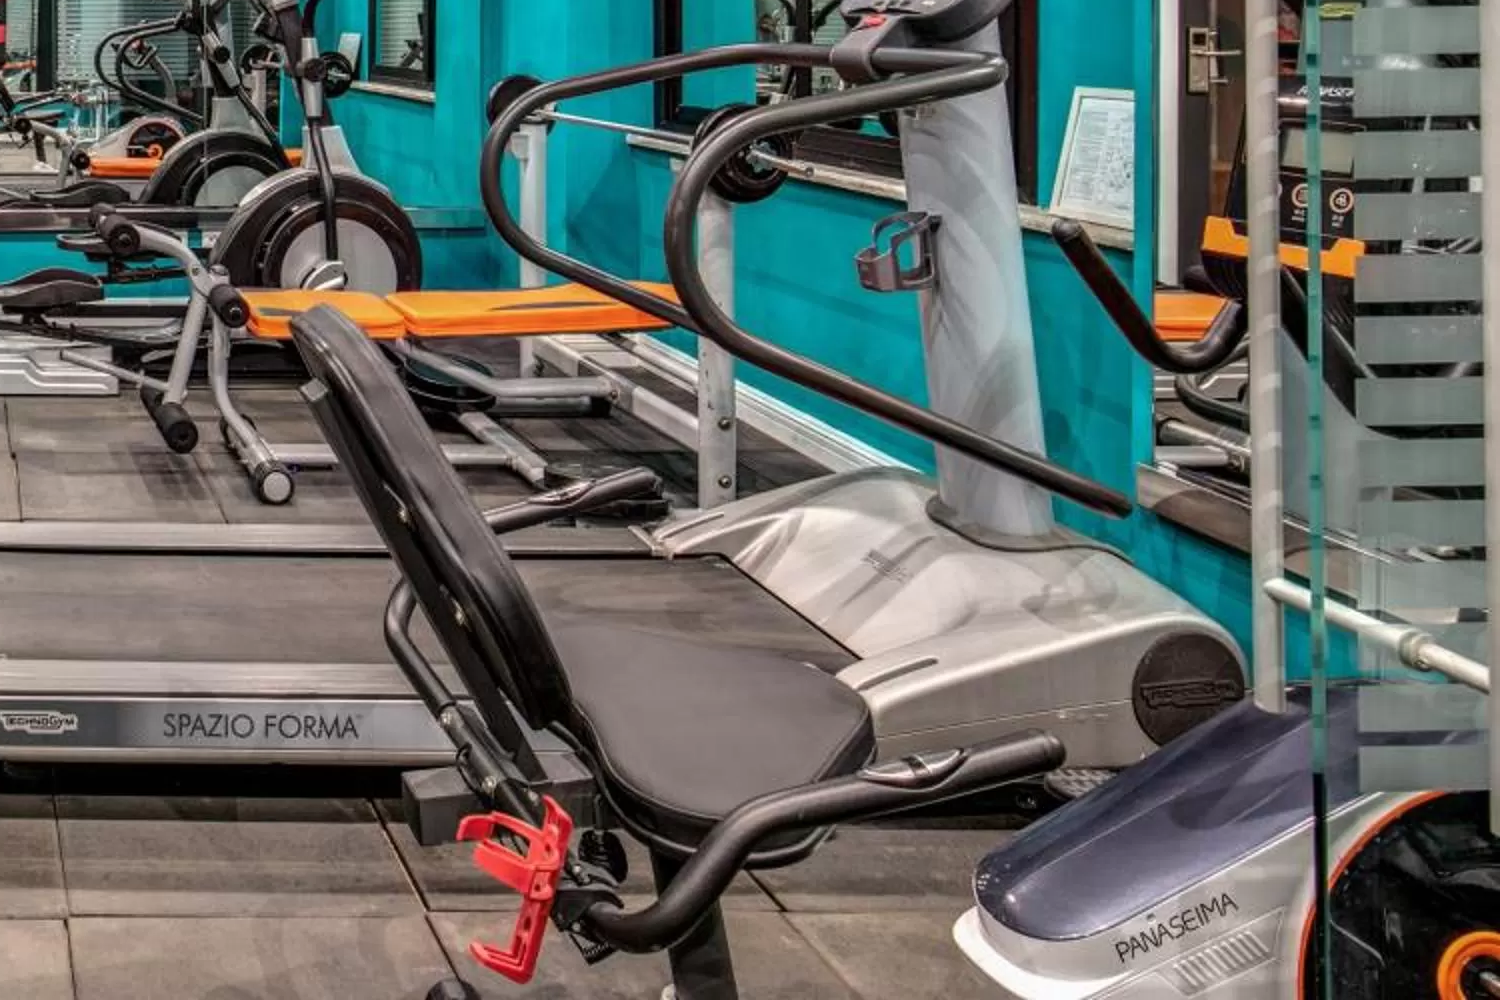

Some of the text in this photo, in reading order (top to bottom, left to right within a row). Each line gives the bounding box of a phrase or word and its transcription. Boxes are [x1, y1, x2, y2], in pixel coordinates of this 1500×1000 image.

[163, 713, 360, 739] SPAZIO FORMA
[1115, 892, 1240, 963] PANASEIMA
